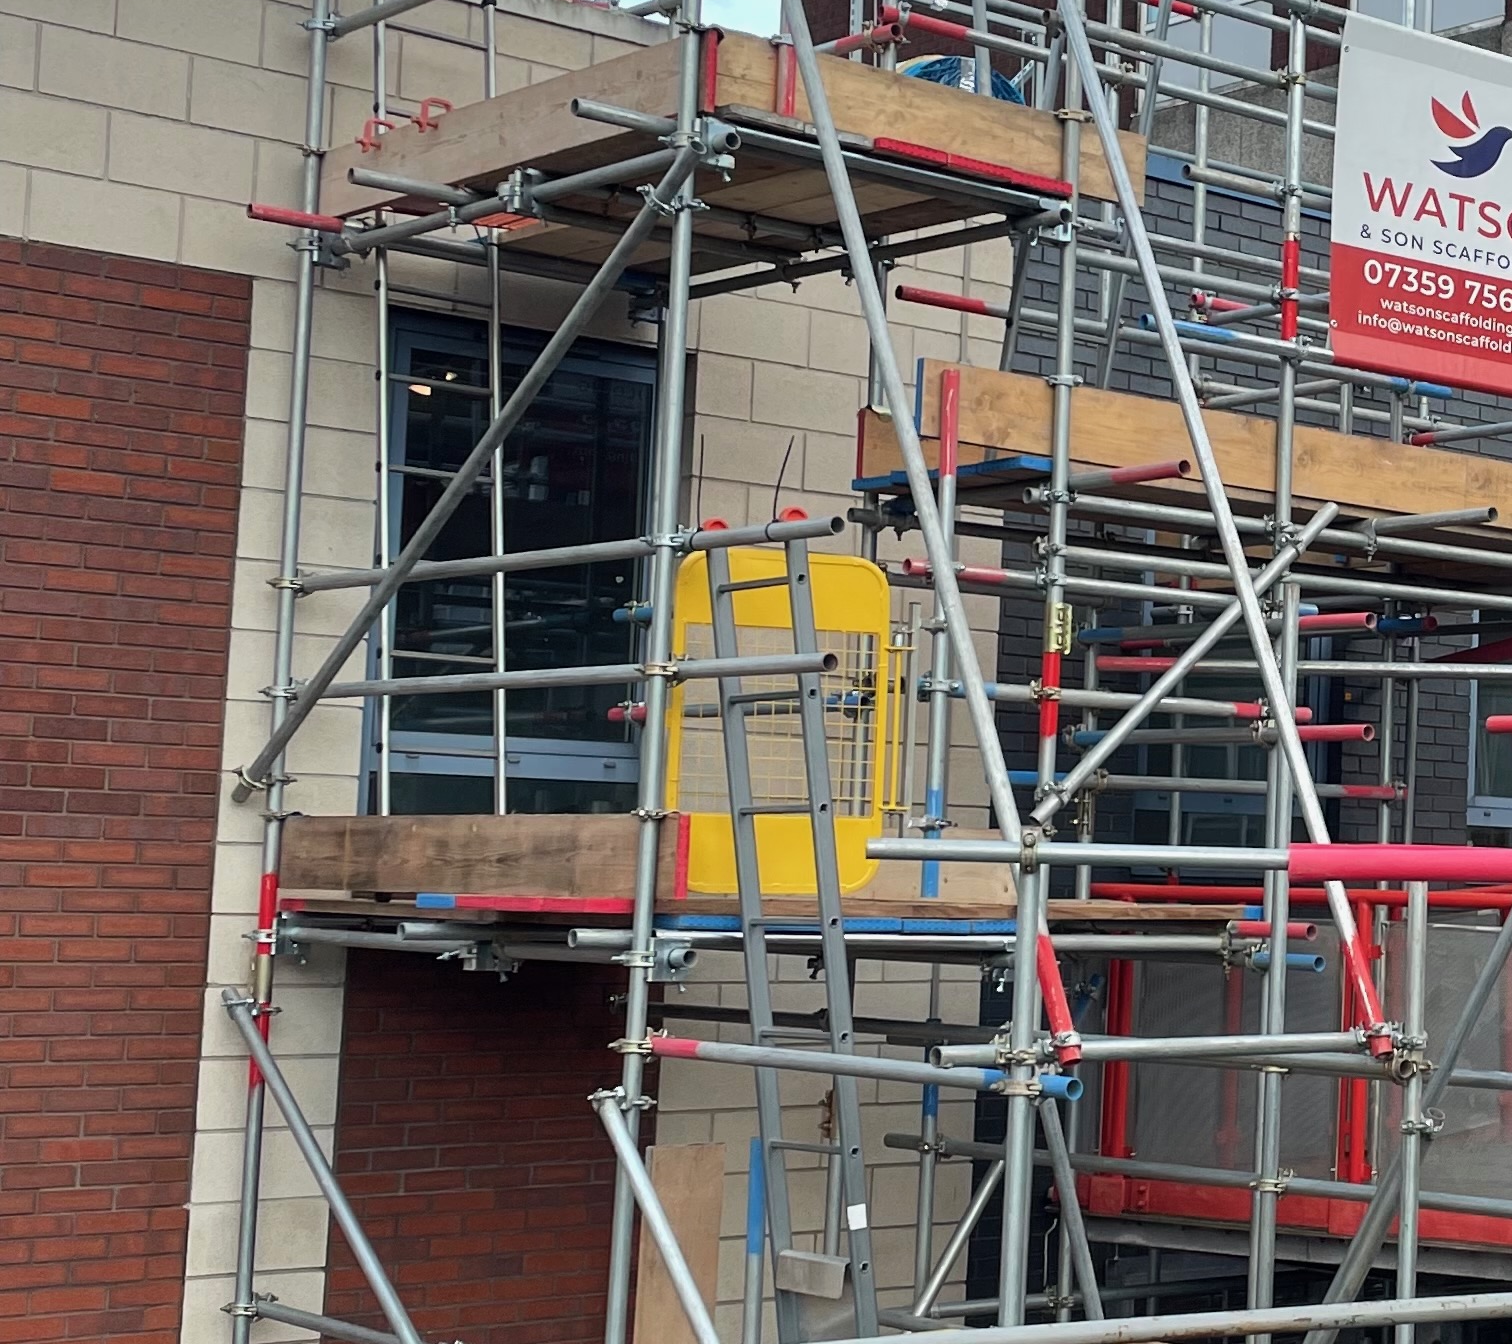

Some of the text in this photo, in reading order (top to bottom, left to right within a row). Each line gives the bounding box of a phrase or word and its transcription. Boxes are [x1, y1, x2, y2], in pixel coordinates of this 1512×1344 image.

[1360, 224, 1371, 239] &
[1381, 228, 1423, 251] SON
[1363, 259, 1455, 300] 07359
